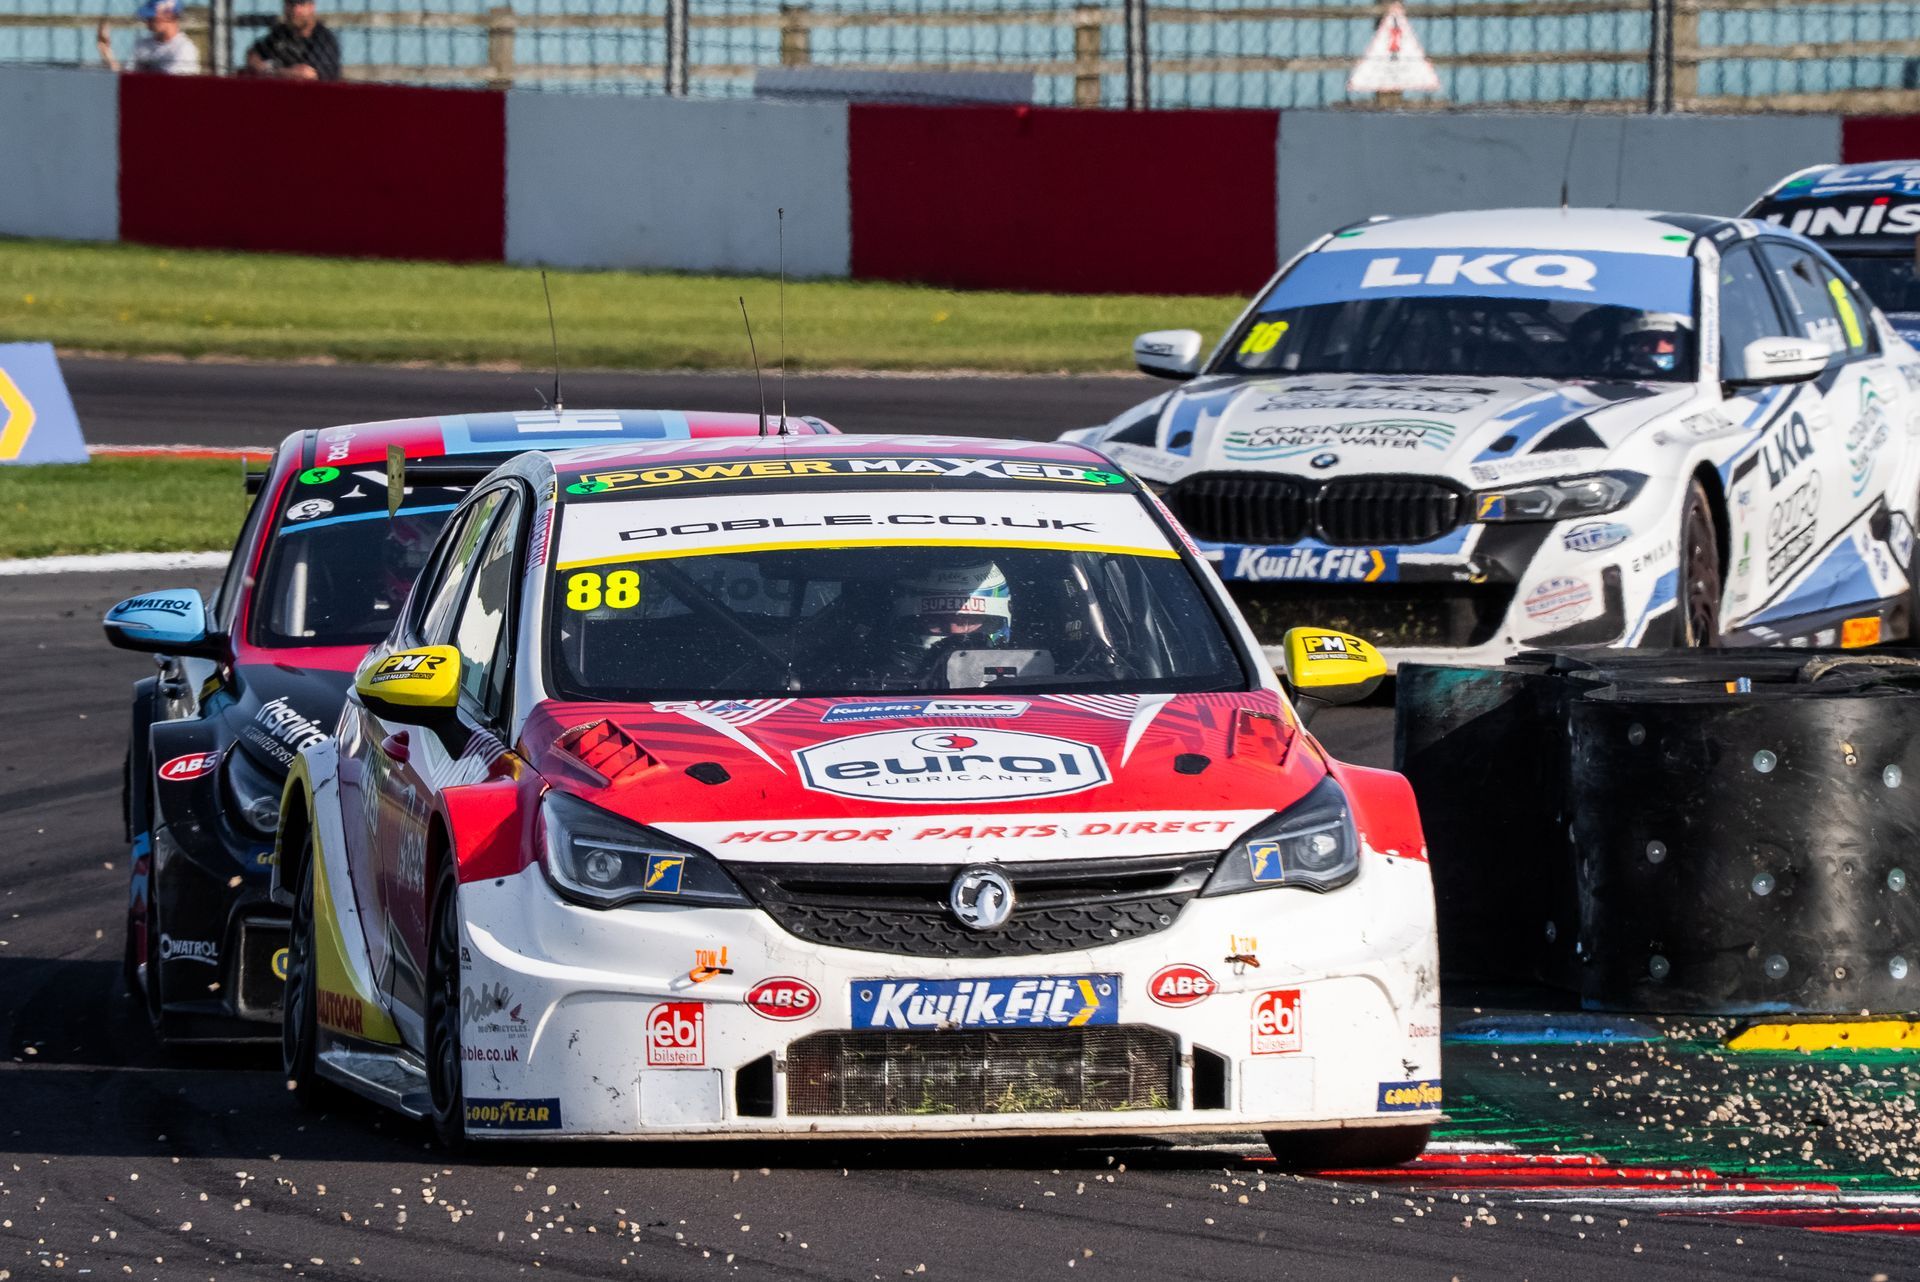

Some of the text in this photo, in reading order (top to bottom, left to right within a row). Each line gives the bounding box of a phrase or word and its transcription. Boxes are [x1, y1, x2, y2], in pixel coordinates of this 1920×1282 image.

[1360, 254, 1598, 292] LKQ
[1239, 321, 1289, 353] 16
[1247, 435, 1315, 447] LAND
[1339, 436, 1419, 450] WATER
[1254, 424, 1426, 439] COGNITION
[1763, 410, 1815, 490] LKQ
[595, 460, 837, 488] POWER
[847, 457, 1086, 480] MAXED
[618, 514, 1099, 542] DOBLE.CO.UK
[566, 569, 641, 611] 88
[113, 598, 192, 614] OWATROL
[921, 598, 986, 613] SUPERHUB
[1303, 636, 1363, 652] PMR
[379, 655, 447, 671] PMR
[833, 705, 882, 715] Kwik
[935, 703, 1016, 711] BTCC
[255, 696, 328, 752] inspire
[168, 754, 217, 776] ABS
[825, 752, 1081, 780] eurol
[867, 773, 1052, 787] LUBRICANTS
[718, 820, 1236, 845] MOTOR PARTS DIRECT
[160, 933, 218, 958] OWATROL
[695, 950, 717, 966] TOW
[1158, 977, 1210, 996] ABS
[757, 989, 811, 1008] ABS
[870, 979, 1075, 1029] Kwik Fit
[1251, 993, 1301, 1034] febi
[646, 1005, 704, 1046] febi
[654, 1049, 698, 1062] bilstein
[465, 1101, 550, 1125] GOODYEAR
